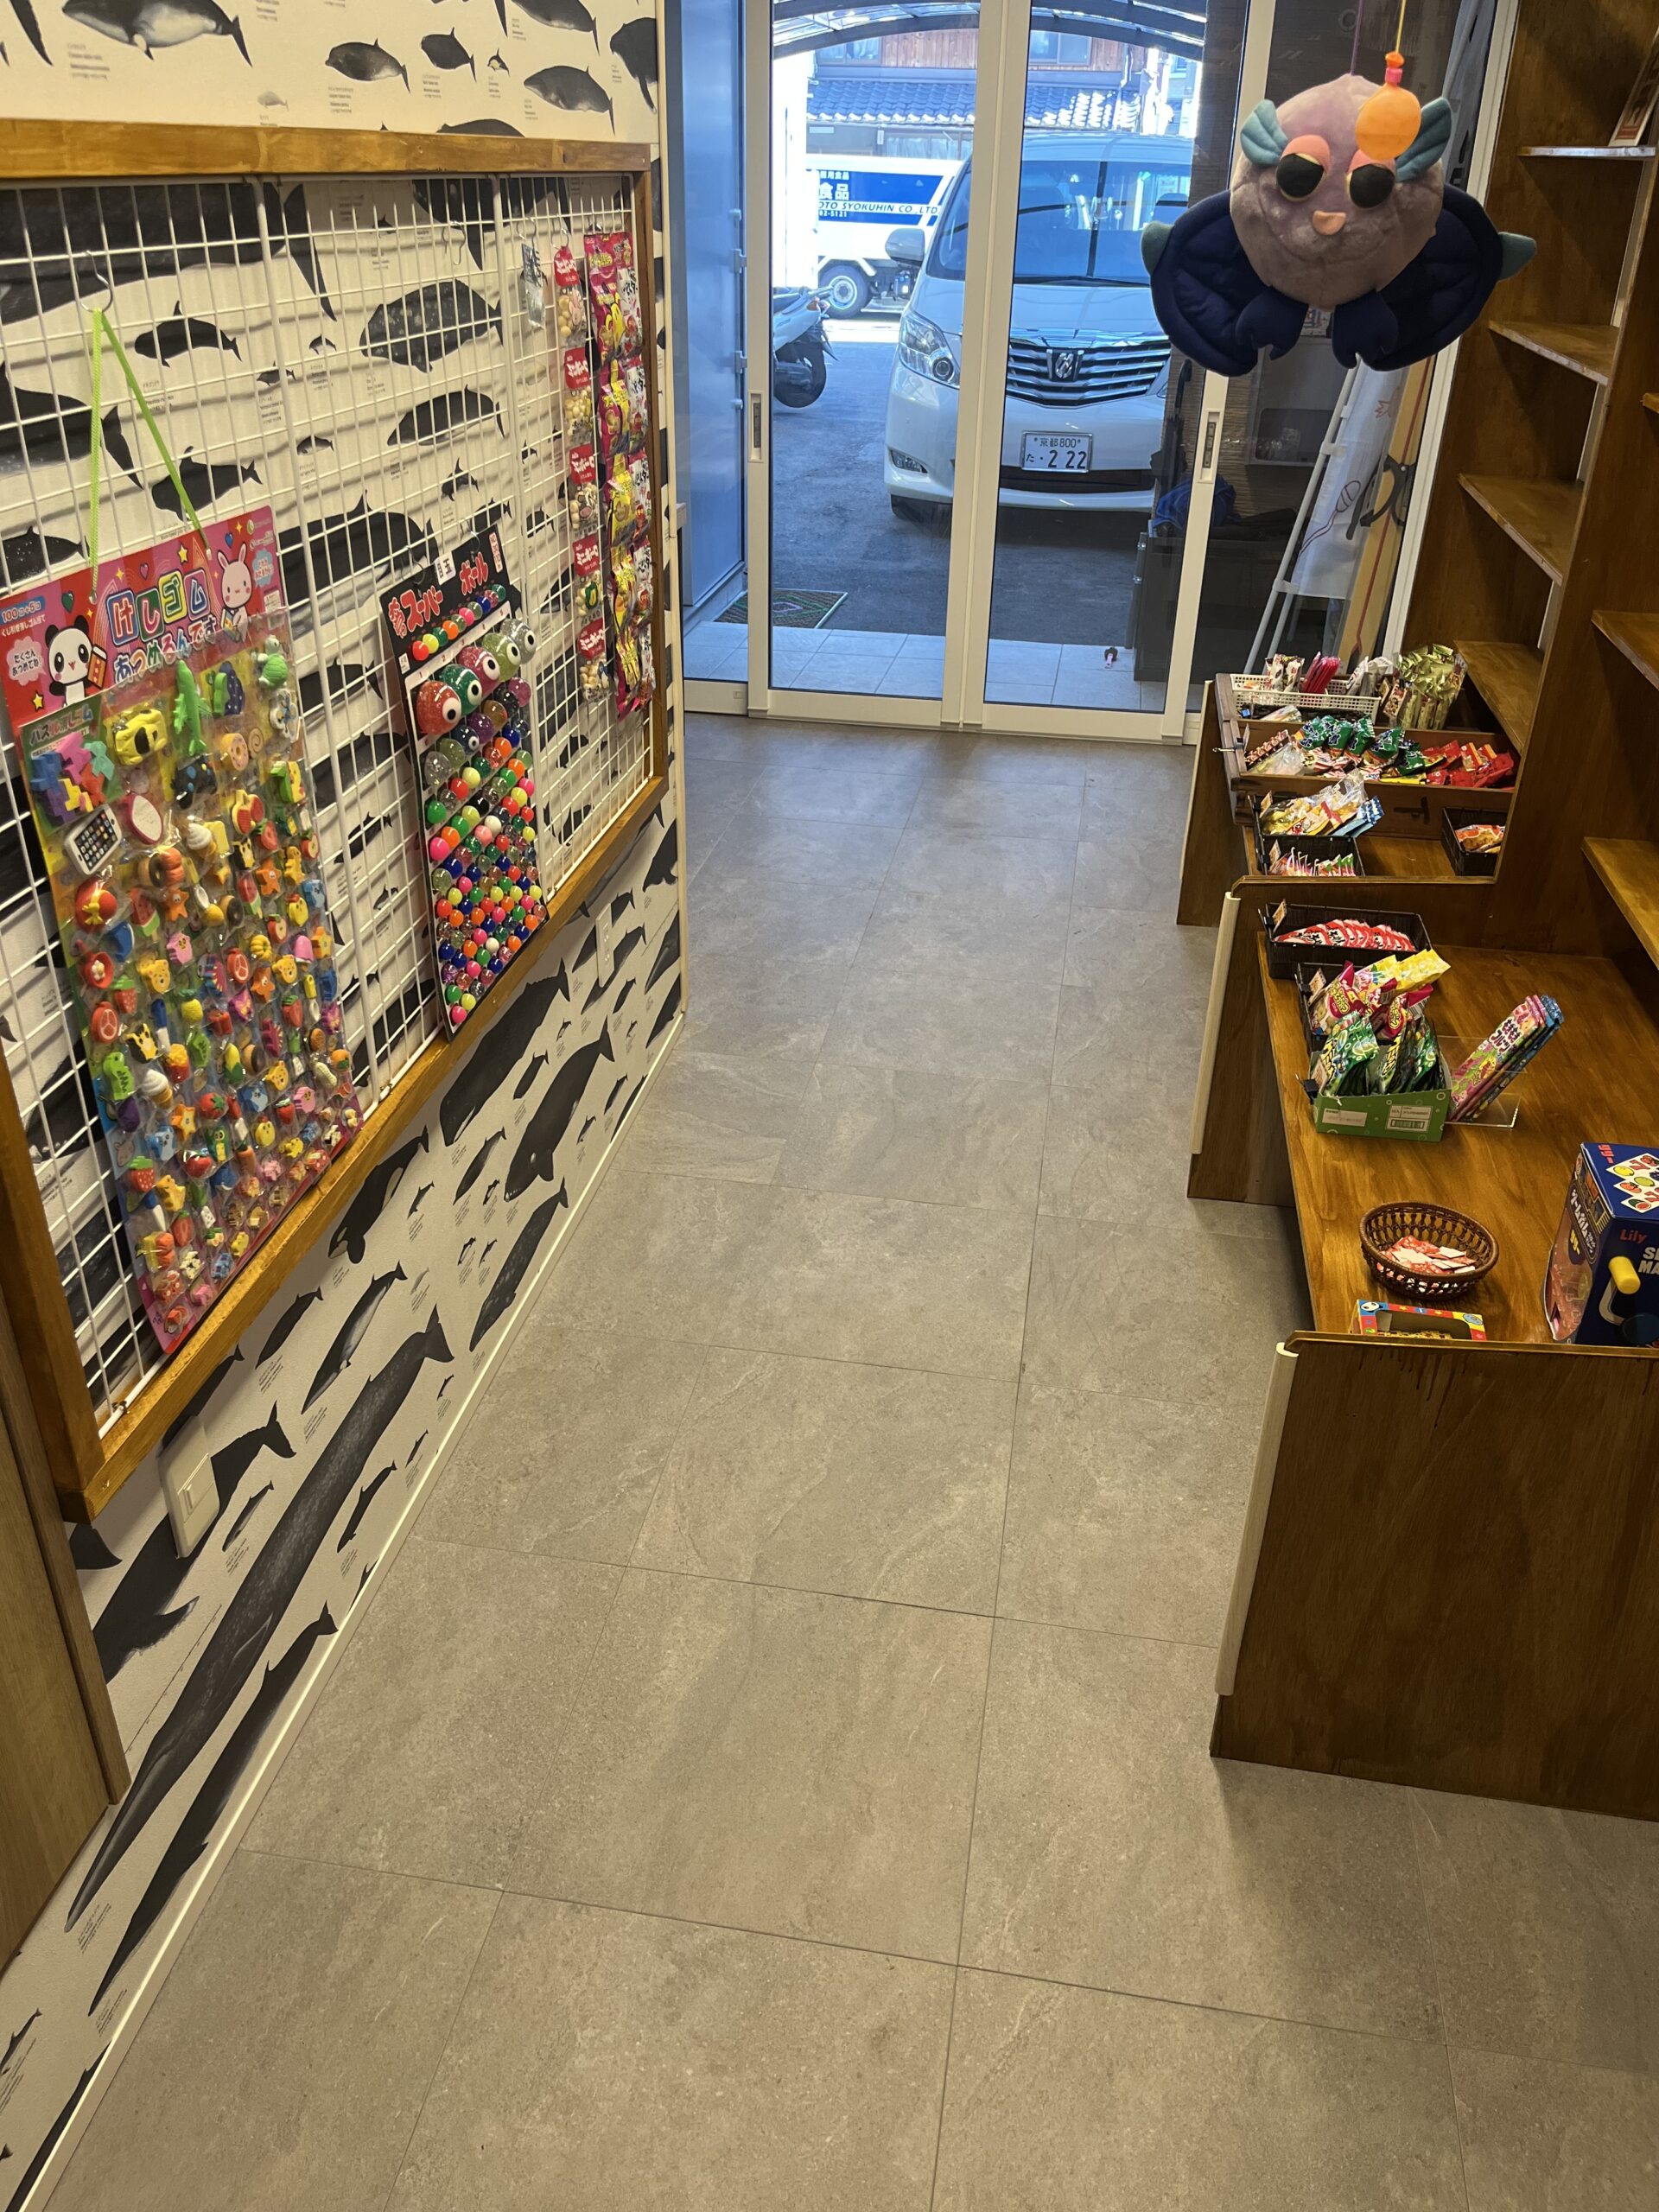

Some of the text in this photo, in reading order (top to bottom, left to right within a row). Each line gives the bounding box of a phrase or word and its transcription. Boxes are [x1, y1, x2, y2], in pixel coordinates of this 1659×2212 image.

[842, 202, 894, 212] SYOKUHIN
[460, 551, 489, 596] ボール
[110, 571, 209, 642] けしゴム
[399, 585, 444, 632] スーパー
[14, 650, 36, 664] たくさん
[114, 614, 217, 689] あつめるんです
[1618, 1230, 1648, 1244] Lily
